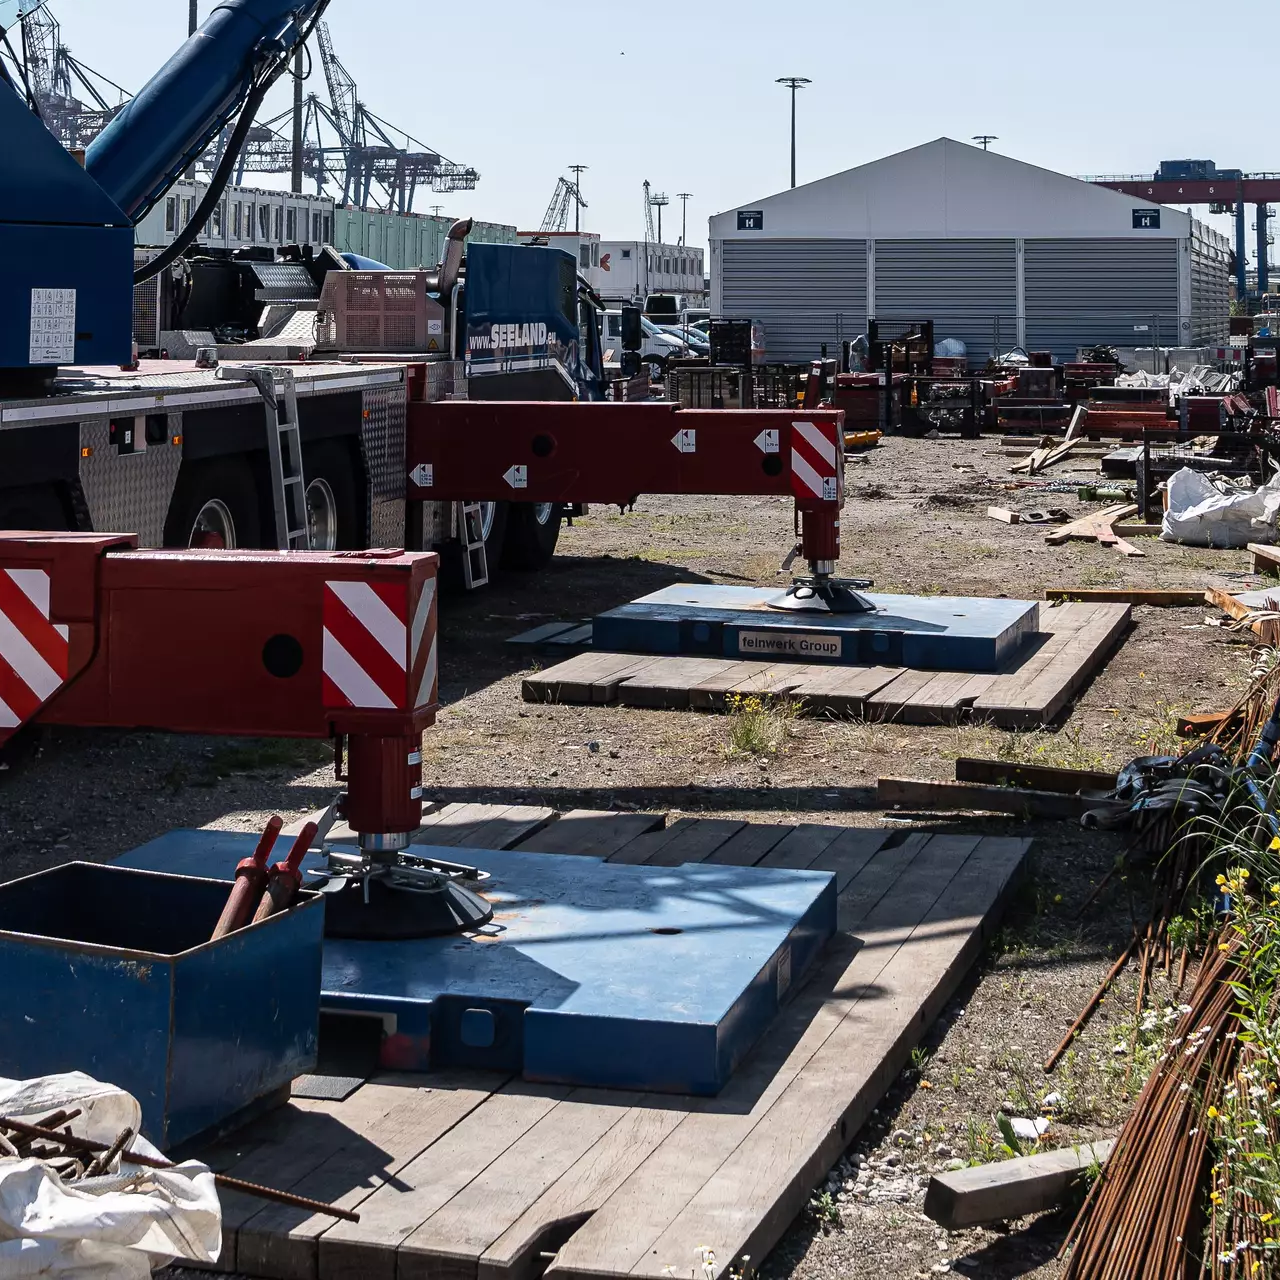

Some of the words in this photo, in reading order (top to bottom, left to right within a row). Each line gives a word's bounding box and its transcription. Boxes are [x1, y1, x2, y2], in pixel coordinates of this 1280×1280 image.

[469, 322, 557, 350] www.SEELAND.eu
[742, 636, 796, 650] feinwerk
[799, 639, 838, 654] Group
